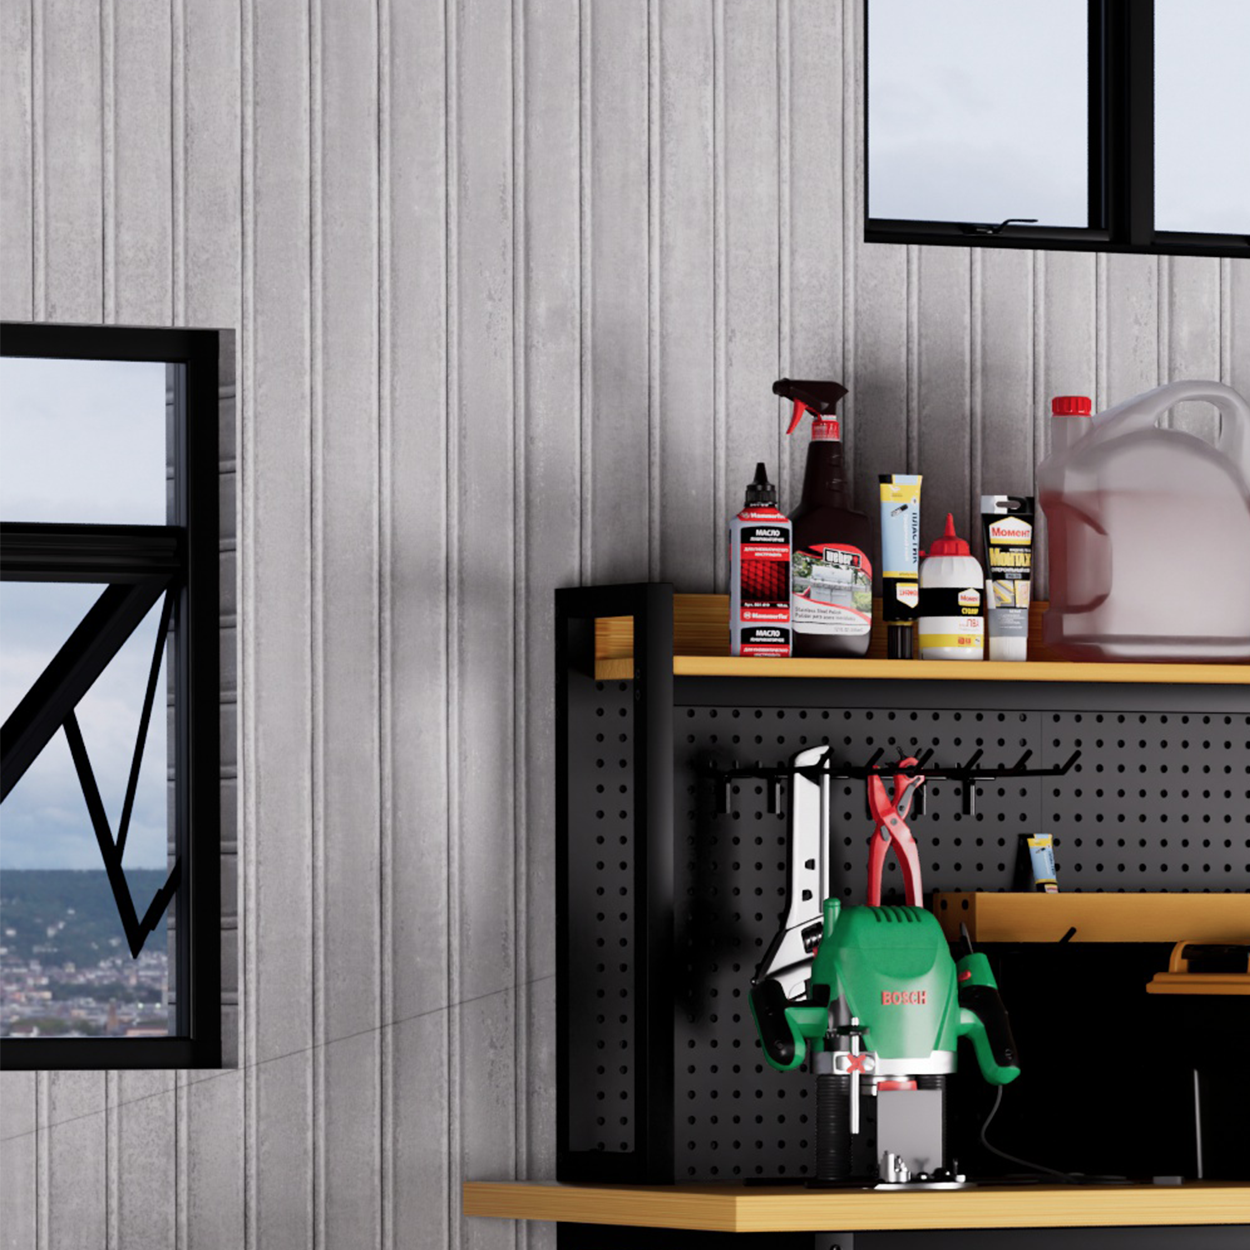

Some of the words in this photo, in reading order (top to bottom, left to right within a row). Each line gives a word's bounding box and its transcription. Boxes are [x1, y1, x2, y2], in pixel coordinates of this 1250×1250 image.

[755, 529, 781, 537] МАСЛО
[755, 630, 781, 638] МАСЛО
[881, 990, 927, 1006] BOSCH
